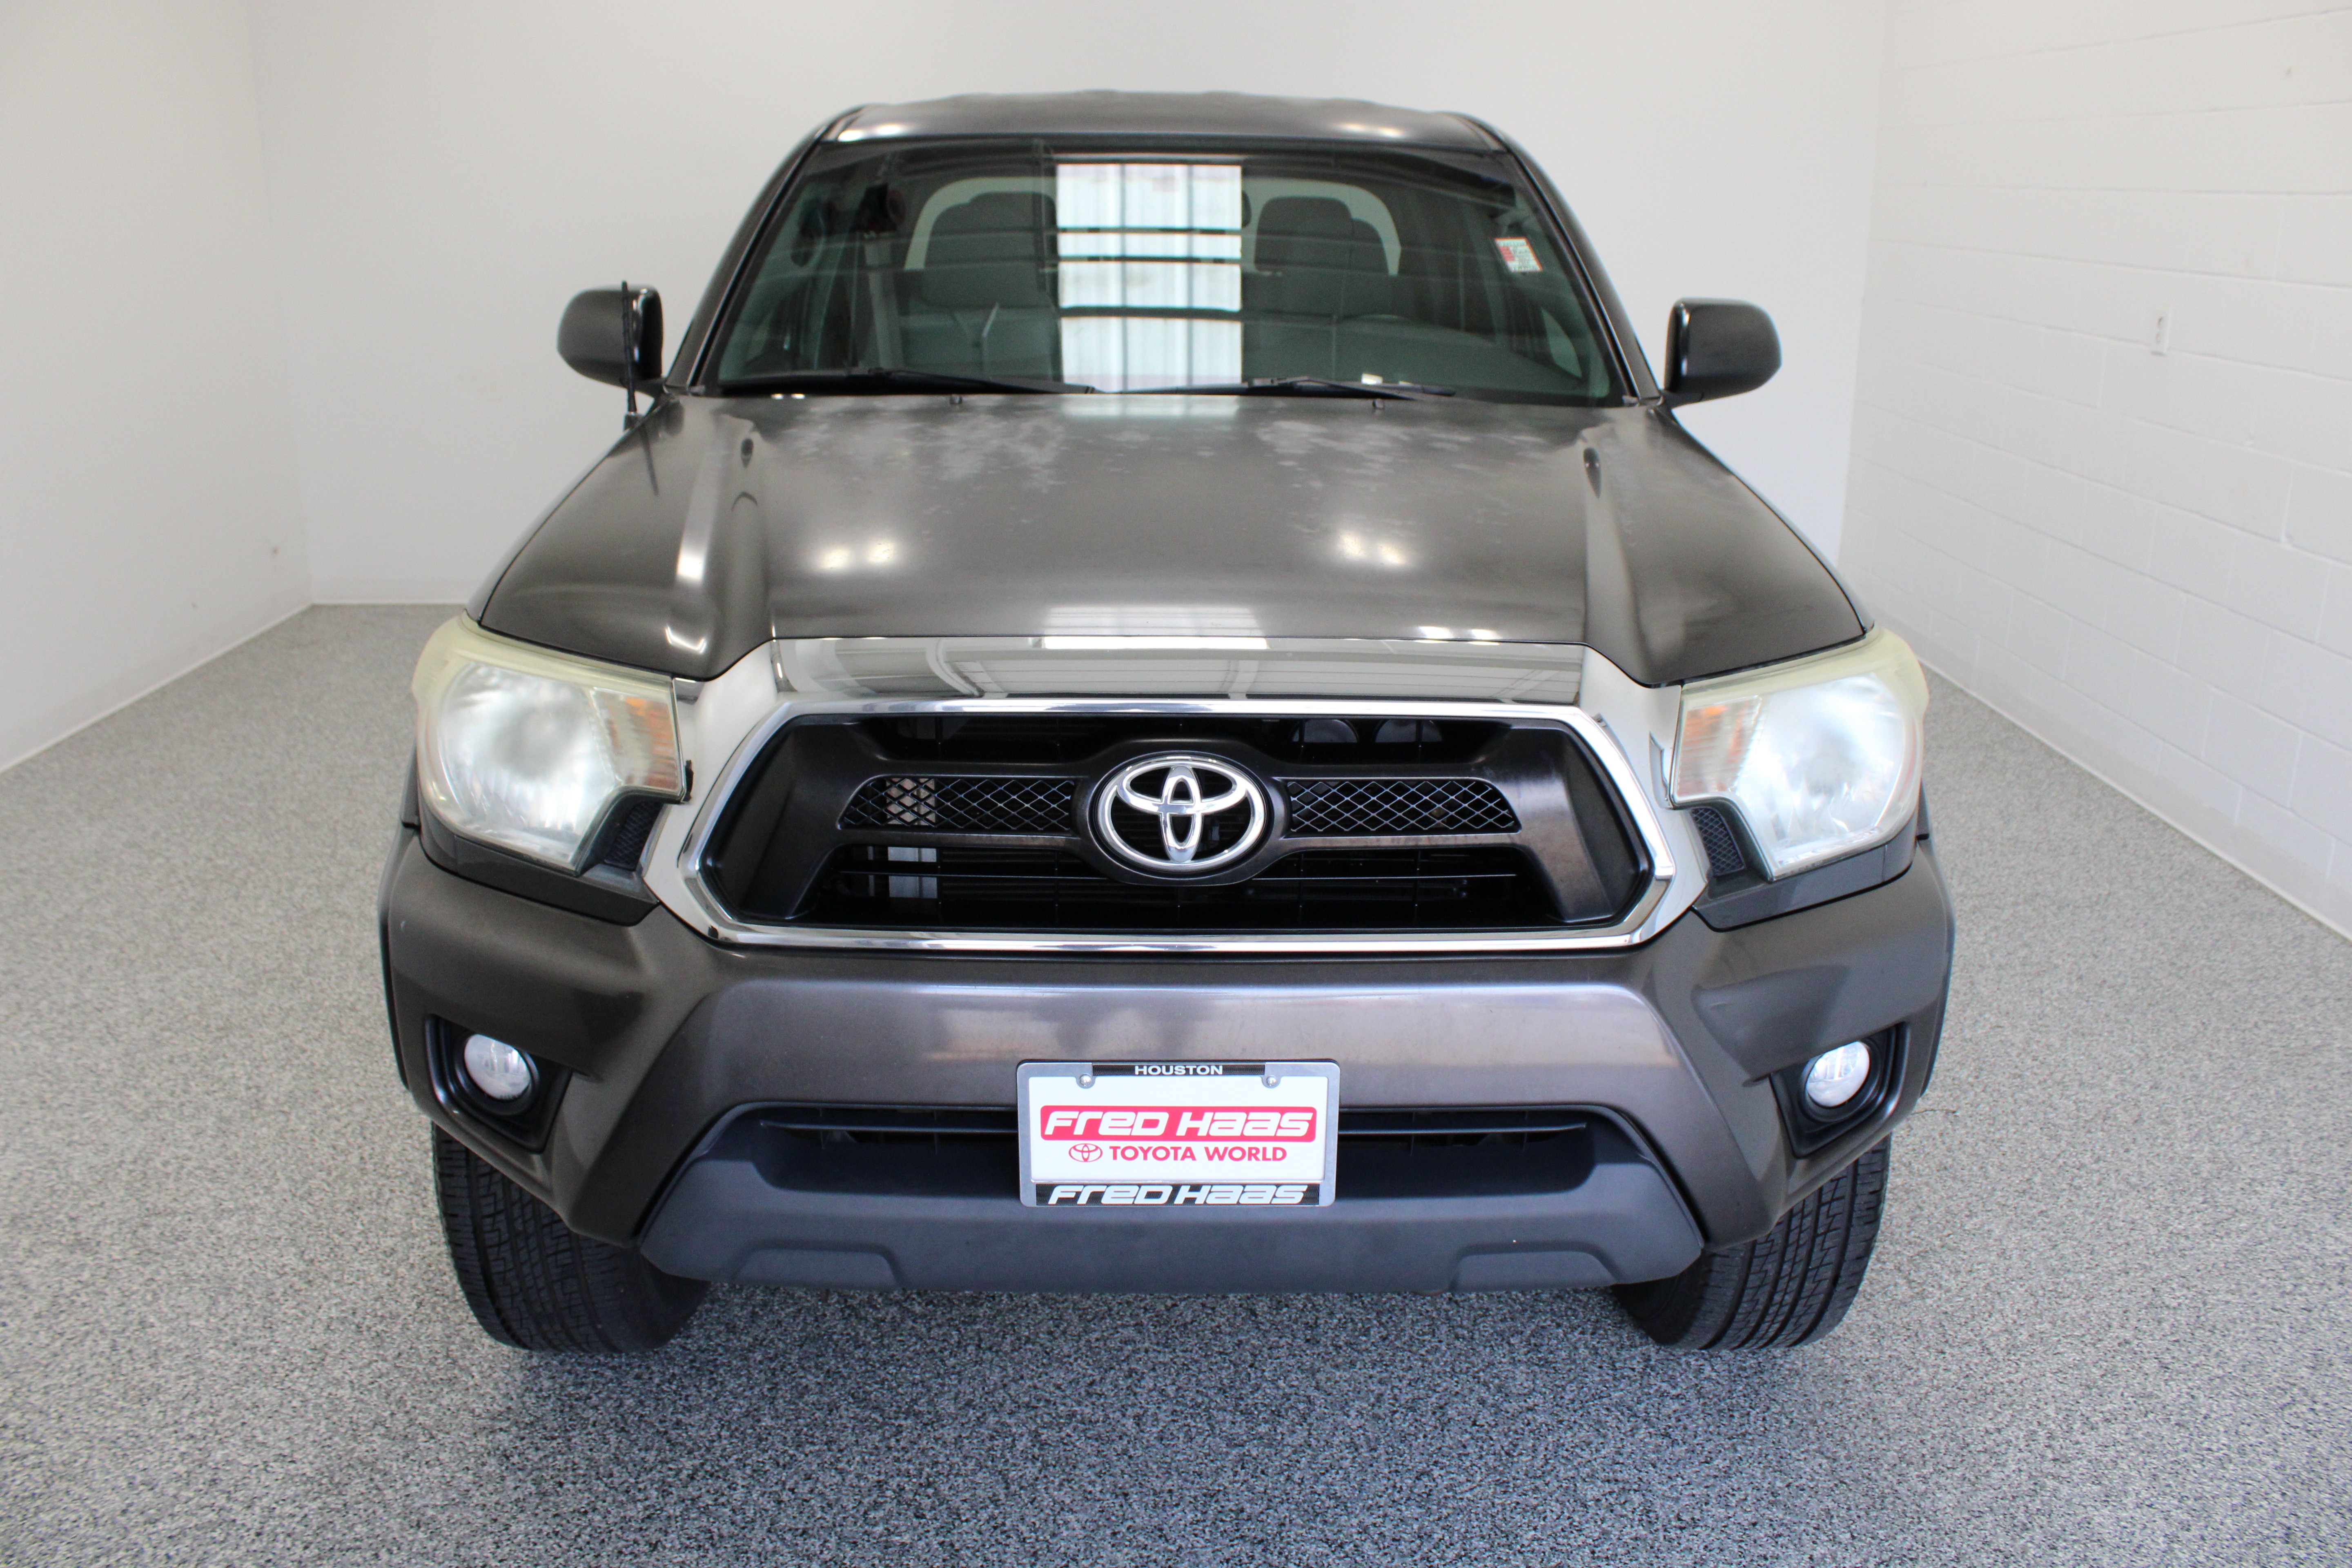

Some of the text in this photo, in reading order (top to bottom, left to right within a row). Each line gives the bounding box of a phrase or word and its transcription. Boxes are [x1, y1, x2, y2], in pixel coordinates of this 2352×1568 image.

[1135, 1065, 1223, 1075] HOUSTON
[1109, 1146, 1287, 1161] TOYOTA WORLD
